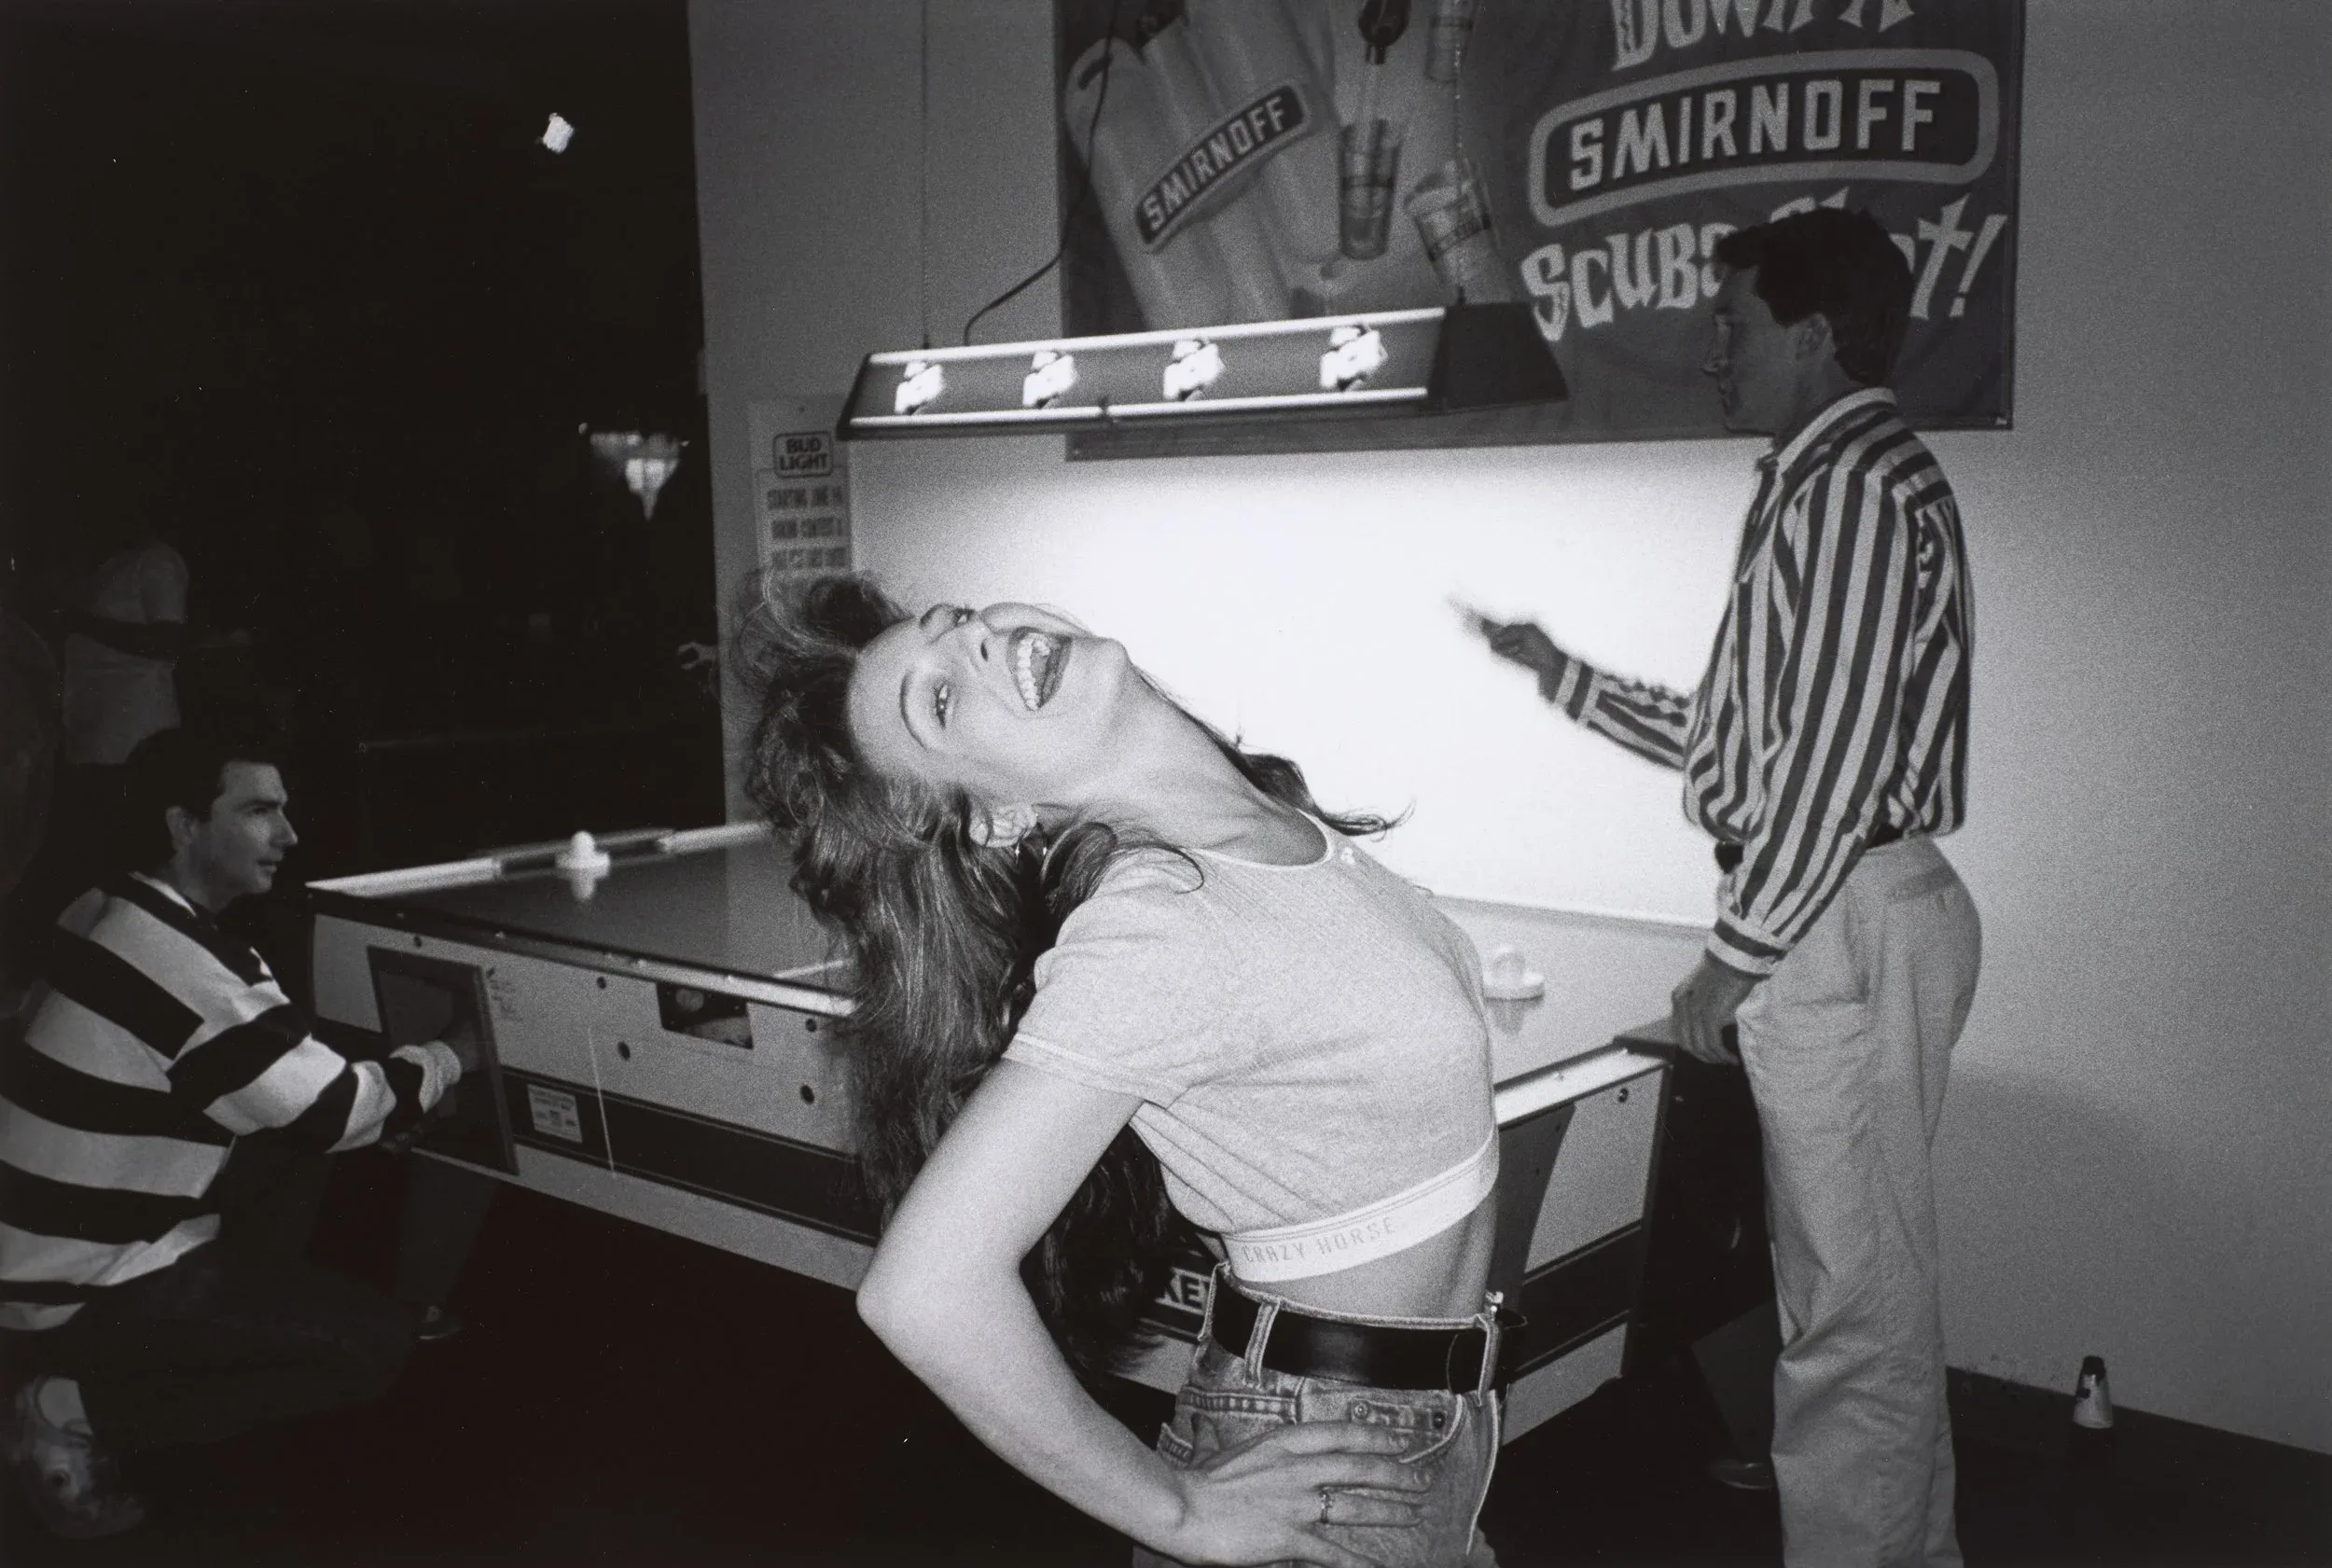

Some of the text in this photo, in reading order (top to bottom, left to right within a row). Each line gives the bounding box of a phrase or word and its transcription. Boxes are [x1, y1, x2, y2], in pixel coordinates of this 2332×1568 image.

[1569, 78, 1941, 192] SMIRNOFF
[1142, 95, 1284, 232] SMIRNOFF
[779, 453, 828, 470] LIGHT
[786, 437, 822, 454] BUD
[1240, 1216, 1396, 1264] CRAZY HORSE
